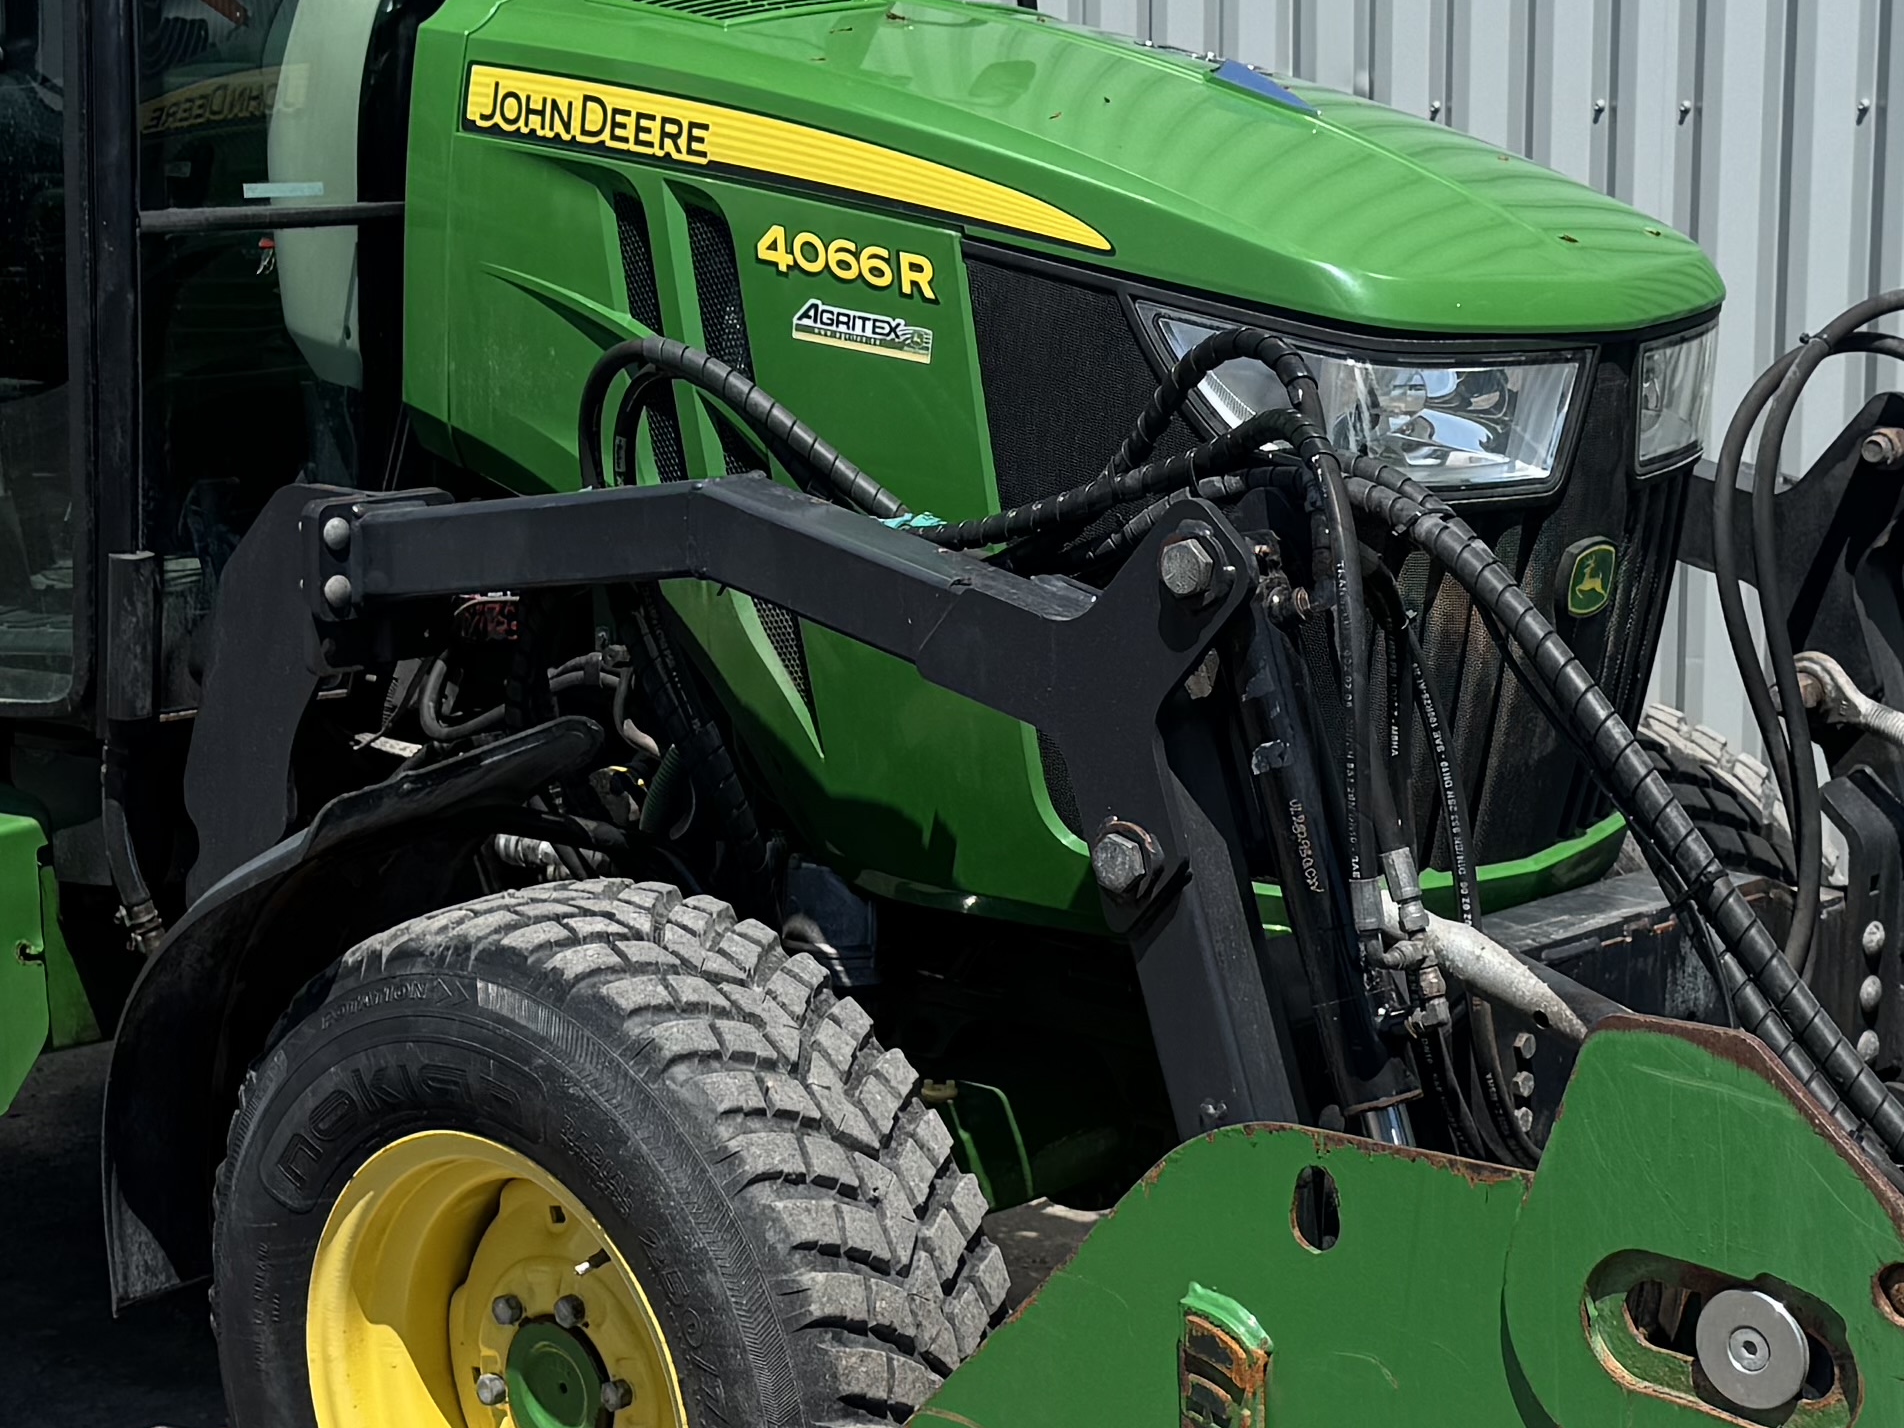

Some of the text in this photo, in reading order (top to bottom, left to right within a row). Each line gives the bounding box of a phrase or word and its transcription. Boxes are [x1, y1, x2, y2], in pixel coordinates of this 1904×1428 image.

[479, 81, 711, 161] JOHN DEERE
[795, 302, 903, 340] AGRITEX
